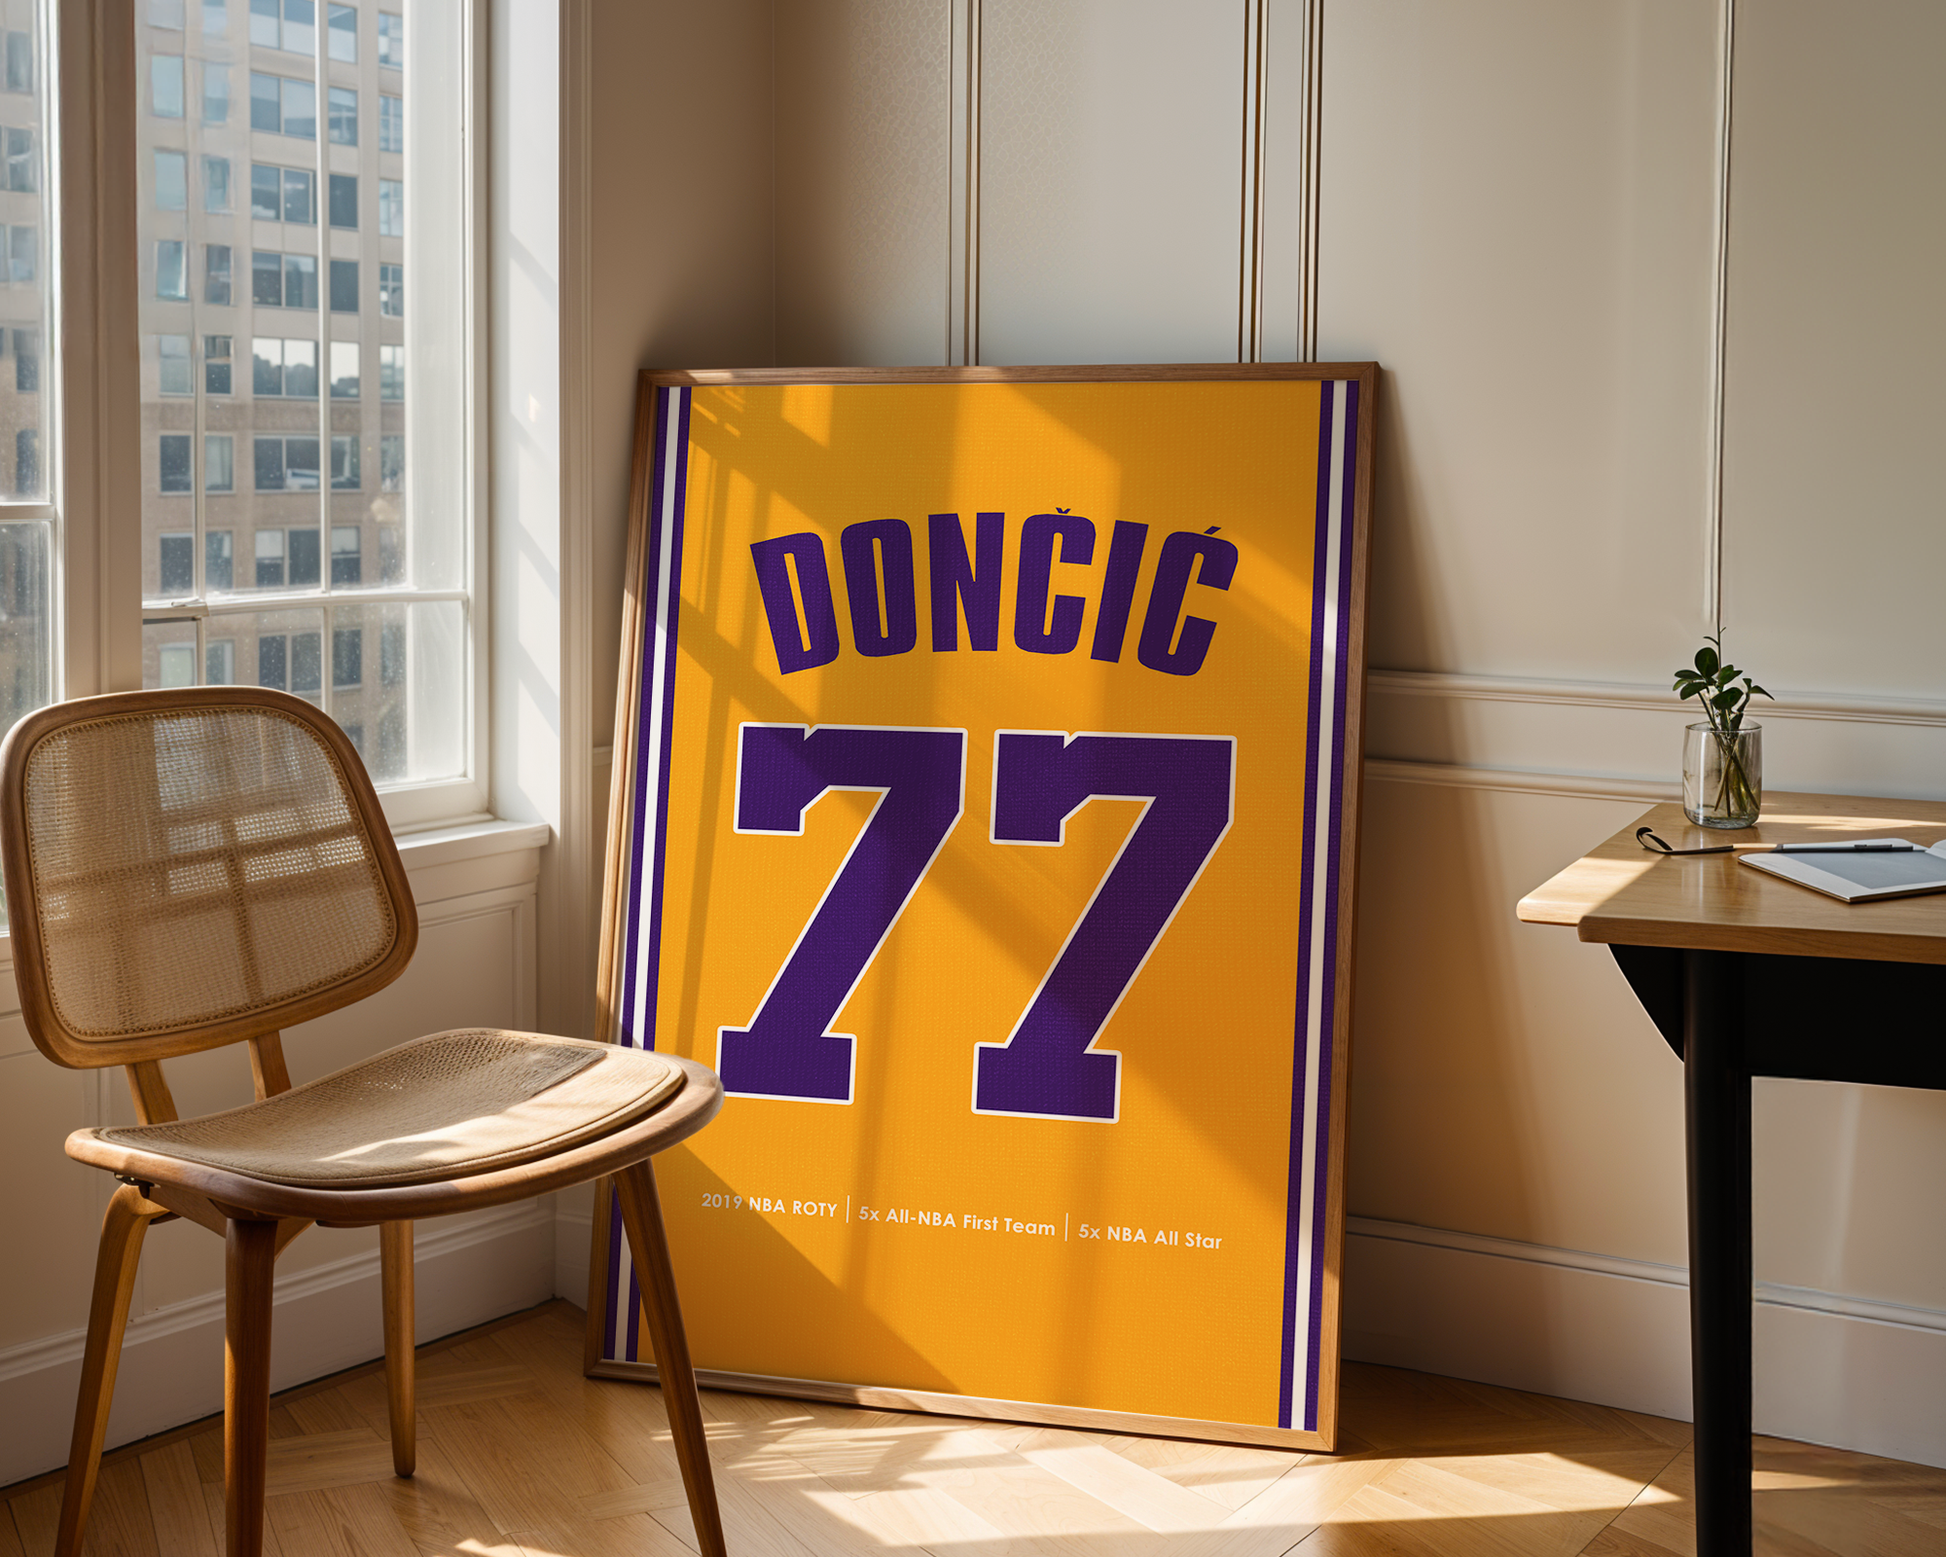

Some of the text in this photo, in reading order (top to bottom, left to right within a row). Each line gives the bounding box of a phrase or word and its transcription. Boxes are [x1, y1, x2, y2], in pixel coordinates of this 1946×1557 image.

[749, 507, 1239, 677] DONČIĆ
[716, 721, 1238, 1124] 77
[701, 1193, 1223, 1249] 2019 NBA ROTY 5x All-NBA First Team 5x NBA All Star
